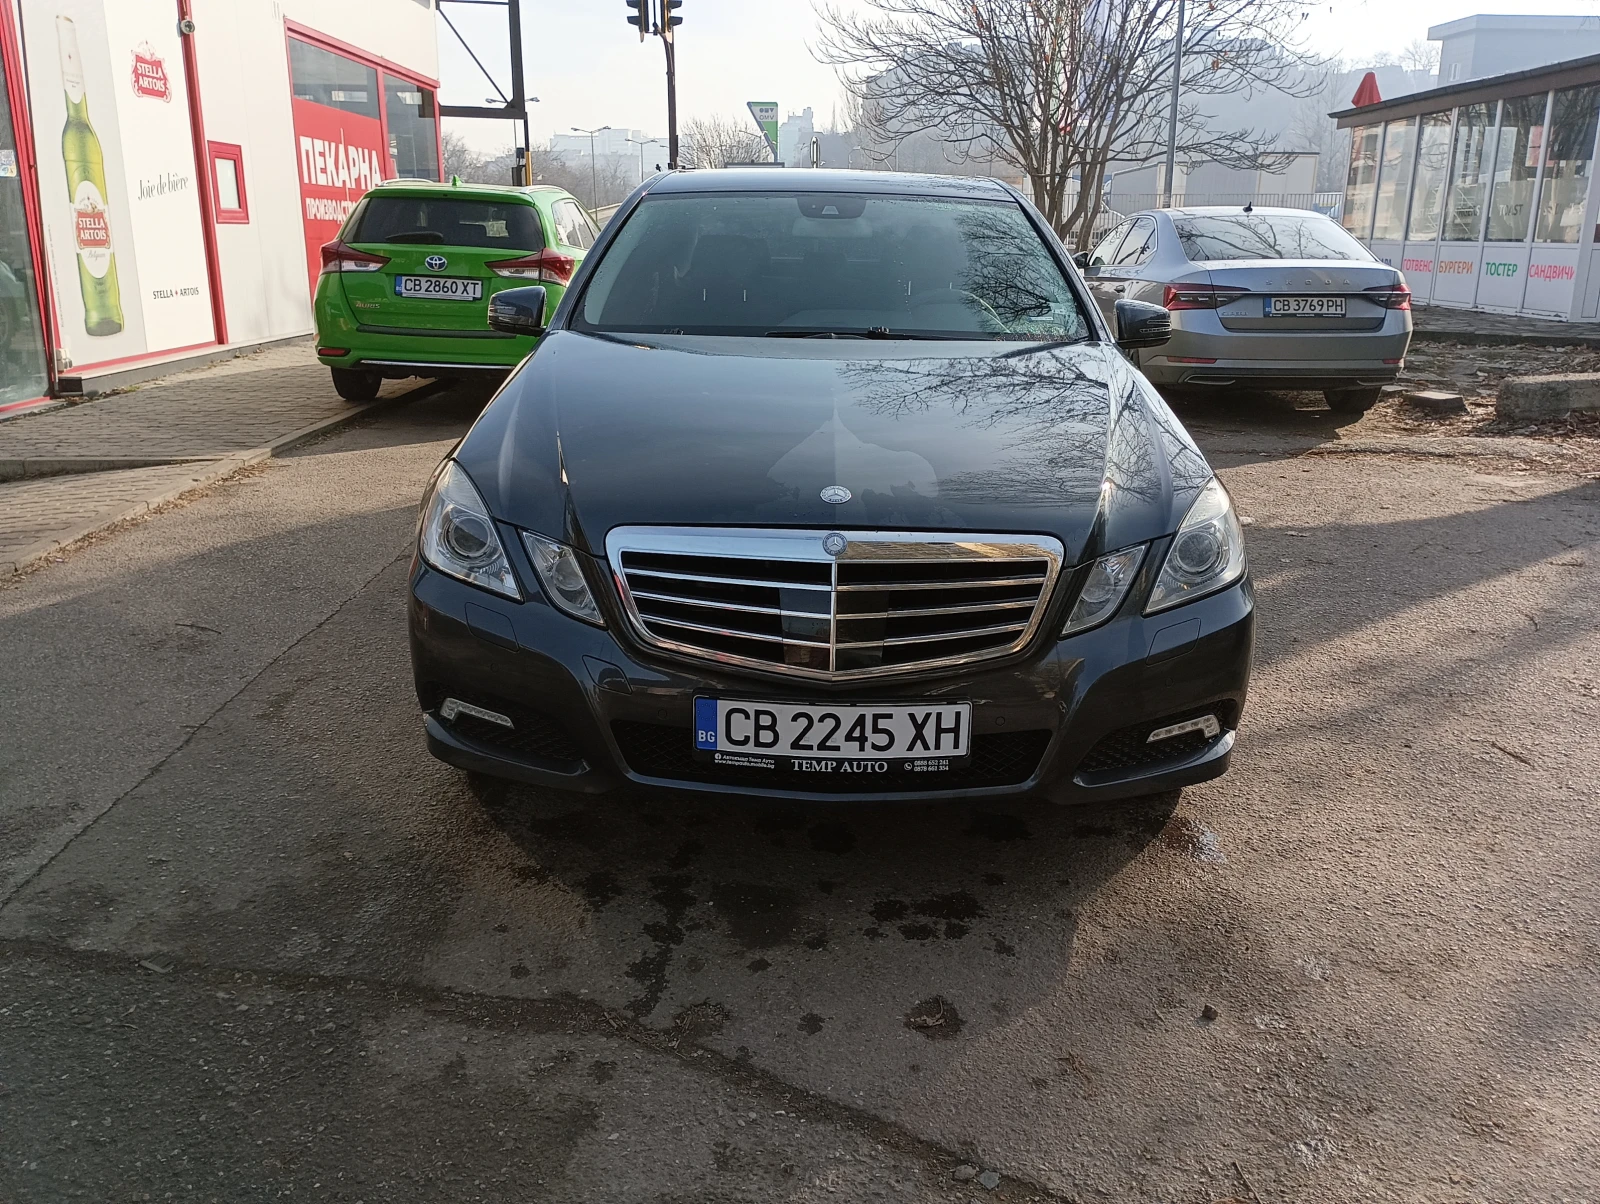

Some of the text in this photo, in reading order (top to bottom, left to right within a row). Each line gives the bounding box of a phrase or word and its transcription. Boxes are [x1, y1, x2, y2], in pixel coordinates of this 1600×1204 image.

[136, 62, 164, 78] STELLA
[138, 75, 166, 92] ARTOIS
[299, 135, 381, 191] ПЕКАРНА
[138, 172, 189, 201] Joie de bière
[1499, 204, 1524, 216] TOAST
[79, 217, 105, 229] STELLA
[80, 229, 107, 240] ARTOIS
[1438, 260, 1474, 275] БУРГЕРИ
[1485, 261, 1519, 278] ТОСТЕР
[152, 287, 200, 299] STELLA ARTOIS
[404, 278, 422, 292] CB
[424, 279, 459, 294] 2860
[1273, 299, 1291, 312] CB
[1293, 299, 1325, 312] 3769
[698, 730, 716, 742] BG
[724, 707, 962, 752] CB 2245 XH
[791, 759, 888, 773] TEMP AUTO
